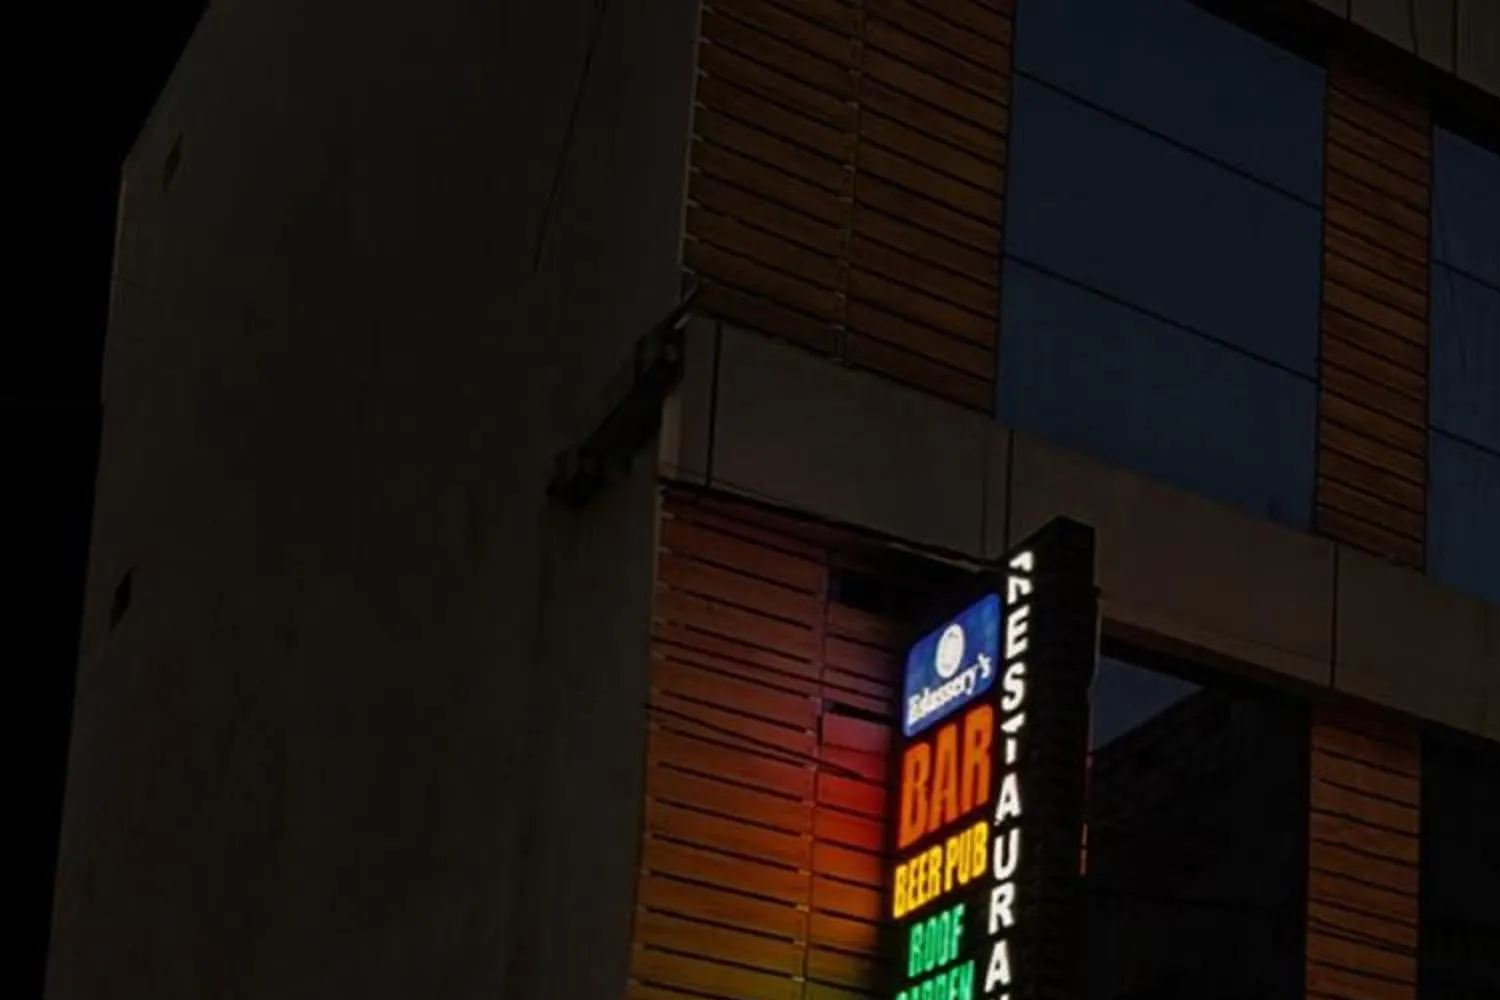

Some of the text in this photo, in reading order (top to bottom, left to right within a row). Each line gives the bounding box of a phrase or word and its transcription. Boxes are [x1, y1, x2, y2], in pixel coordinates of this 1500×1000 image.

[898, 704, 994, 848] BAR
[893, 821, 989, 919] BEER PUB
[908, 903, 965, 978] ROOF
